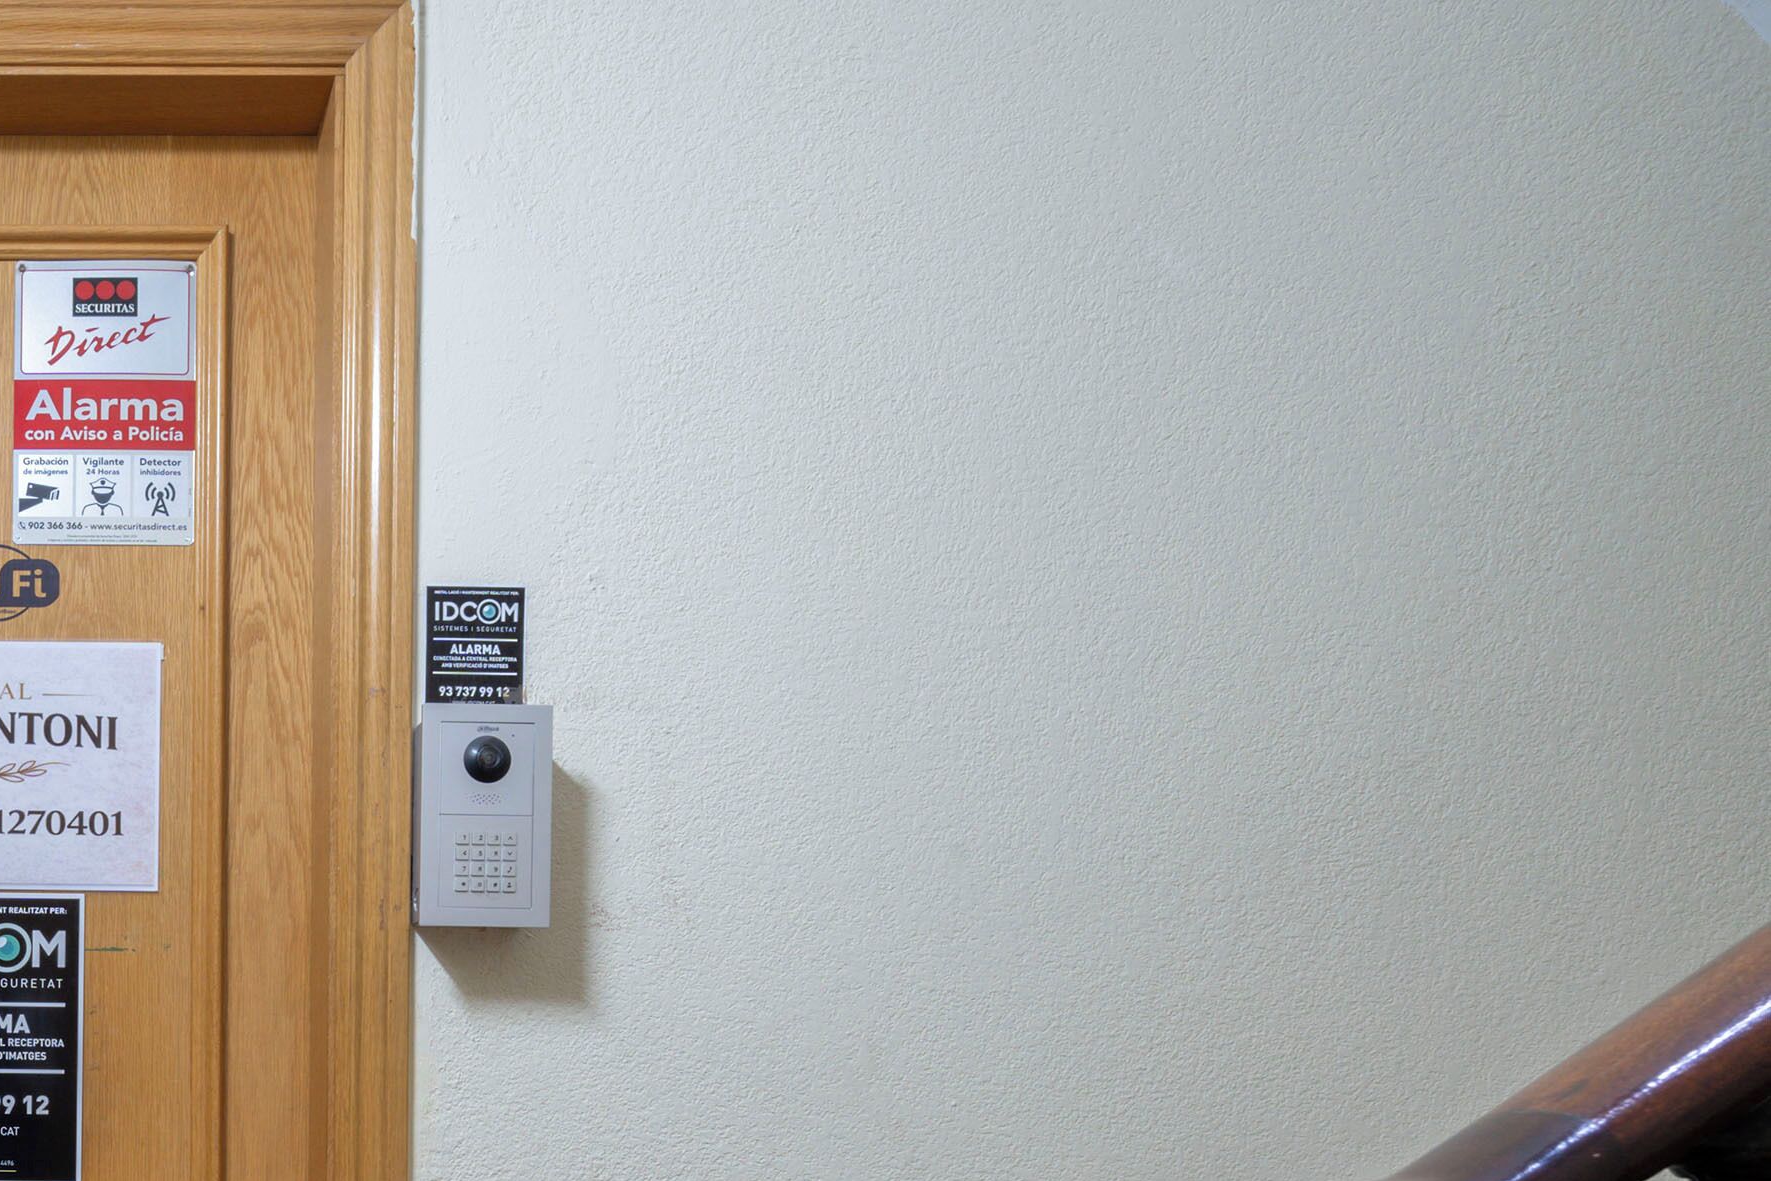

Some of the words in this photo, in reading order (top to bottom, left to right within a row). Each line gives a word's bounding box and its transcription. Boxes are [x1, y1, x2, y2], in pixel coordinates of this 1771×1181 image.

[75, 303, 135, 314] SECURITAS
[44, 313, 172, 366] Direct
[25, 387, 184, 422] Alarma
[24, 429, 55, 441] con
[60, 426, 108, 441] Aviso
[113, 430, 123, 441] a
[128, 426, 184, 442] Policía
[22, 456, 69, 466] Grabación
[82, 457, 125, 467] Vigilante
[139, 458, 182, 467] Detector
[34, 468, 69, 477] imágenes
[139, 468, 182, 476] inhibidores
[28, 522, 46, 530] 902
[47, 522, 64, 530] 366
[65, 522, 83, 530] 366
[90, 522, 188, 531] www.securitasdirect.es
[434, 598, 519, 624] IDCOM
[449, 643, 501, 655] ALARMA
[438, 685, 454, 697] 93
[455, 686, 477, 697] 737
[479, 686, 494, 698] 99
[495, 686, 511, 698] 12
[8, 906, 49, 915] REALITZAT
[49, 907, 68, 915] PER:
[7, 1038, 65, 1048] RECEPTORA
[22, 1094, 50, 1116] 12
